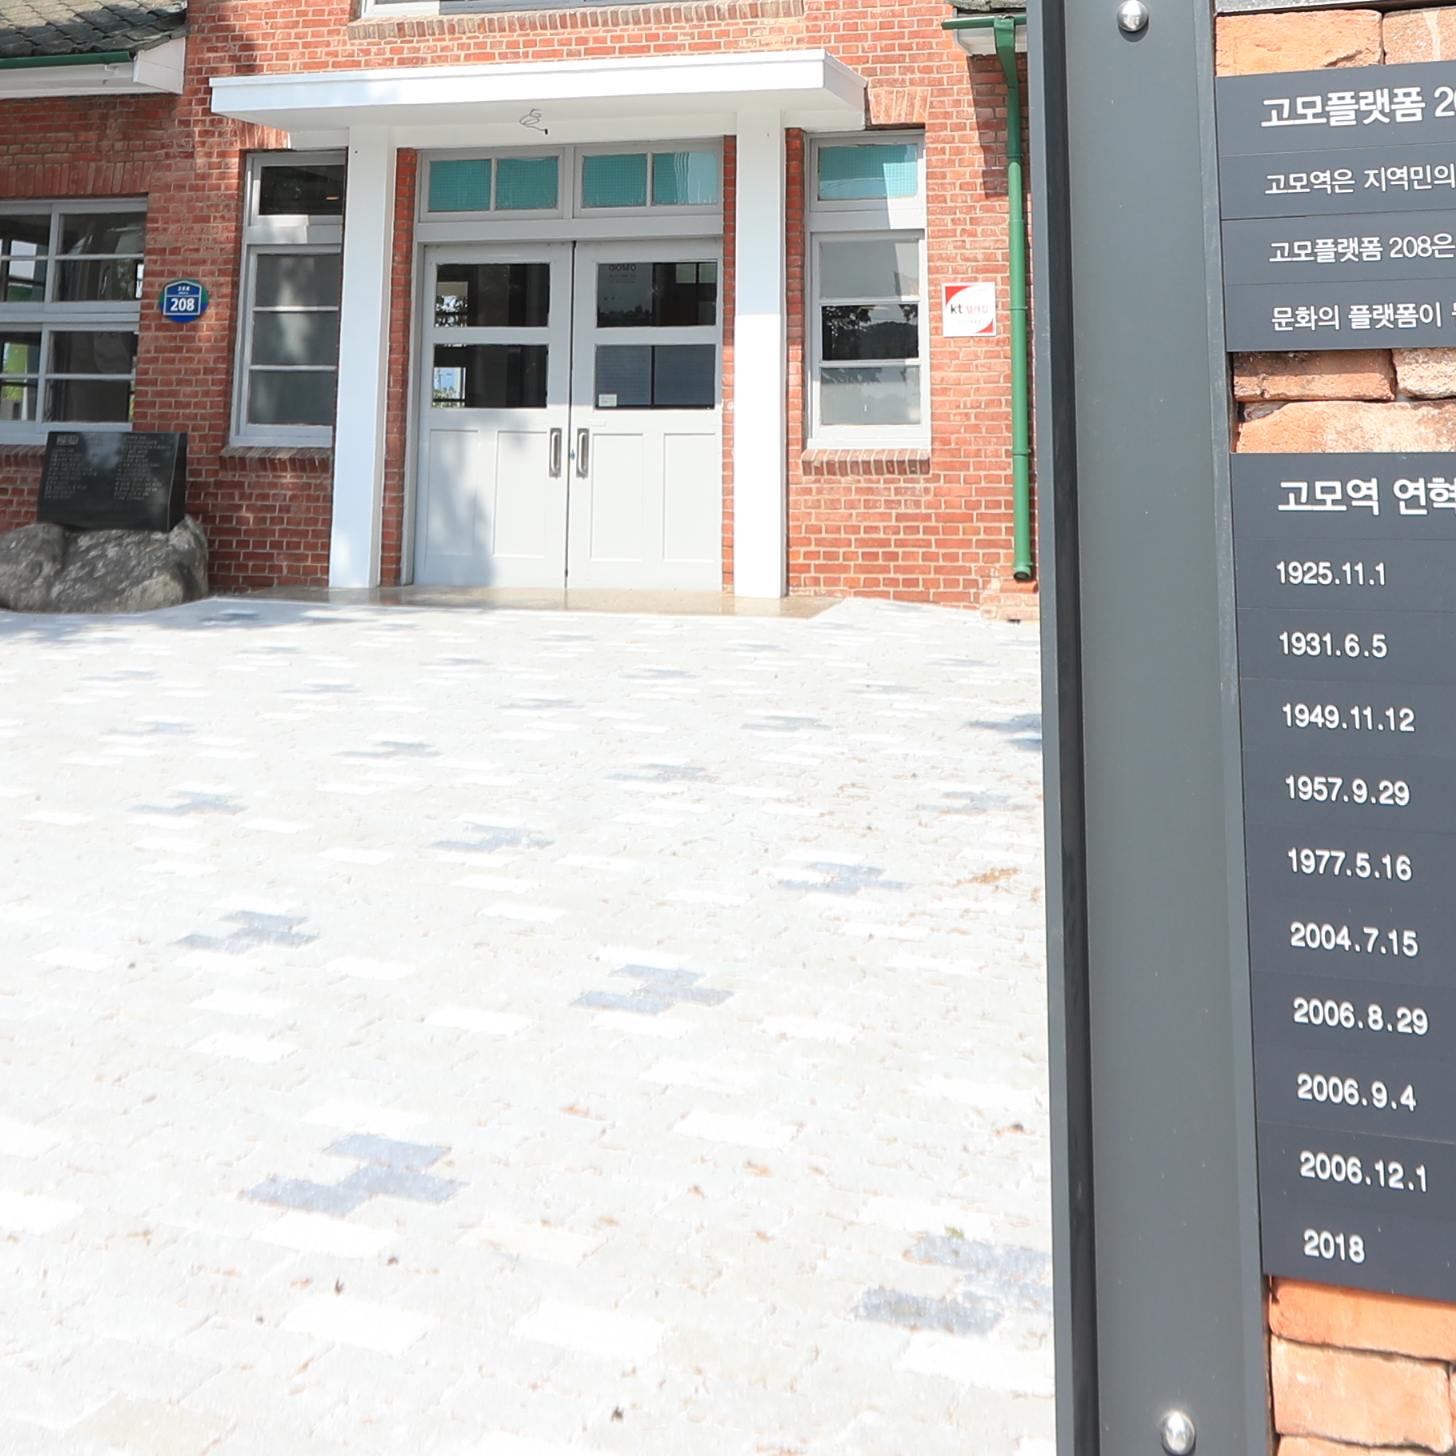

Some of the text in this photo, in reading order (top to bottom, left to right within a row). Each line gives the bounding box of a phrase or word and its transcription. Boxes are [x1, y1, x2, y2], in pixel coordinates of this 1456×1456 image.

[1261, 86, 1426, 127] 고모플랫폼
[1264, 168, 1356, 194] 고모역은
[1363, 163, 1456, 192] 지역민의
[1269, 236, 1384, 263] 고모플랫폼
[1389, 233, 1456, 258] 208은
[170, 297, 195, 312] 208
[950, 303, 964, 314] kt
[1271, 304, 1340, 331] 문화의
[1348, 301, 1442, 329] 플랫폼이
[1277, 477, 1379, 516] 고모역
[1276, 561, 1385, 586] 1925.11.1
[1279, 631, 1387, 658] 1931.6.5
[1282, 703, 1415, 732] 1949.11.12
[1285, 775, 1410, 806] 1957.9.29
[1288, 847, 1412, 881] 1977.5.16
[1290, 921, 1418, 957] 2004.7.15
[1293, 997, 1428, 1035] 2006.8.29
[1297, 1073, 1417, 1111] 2006.9.4
[1300, 1151, 1427, 1192] 2006.12.1
[1303, 1229, 1365, 1263] 2018
